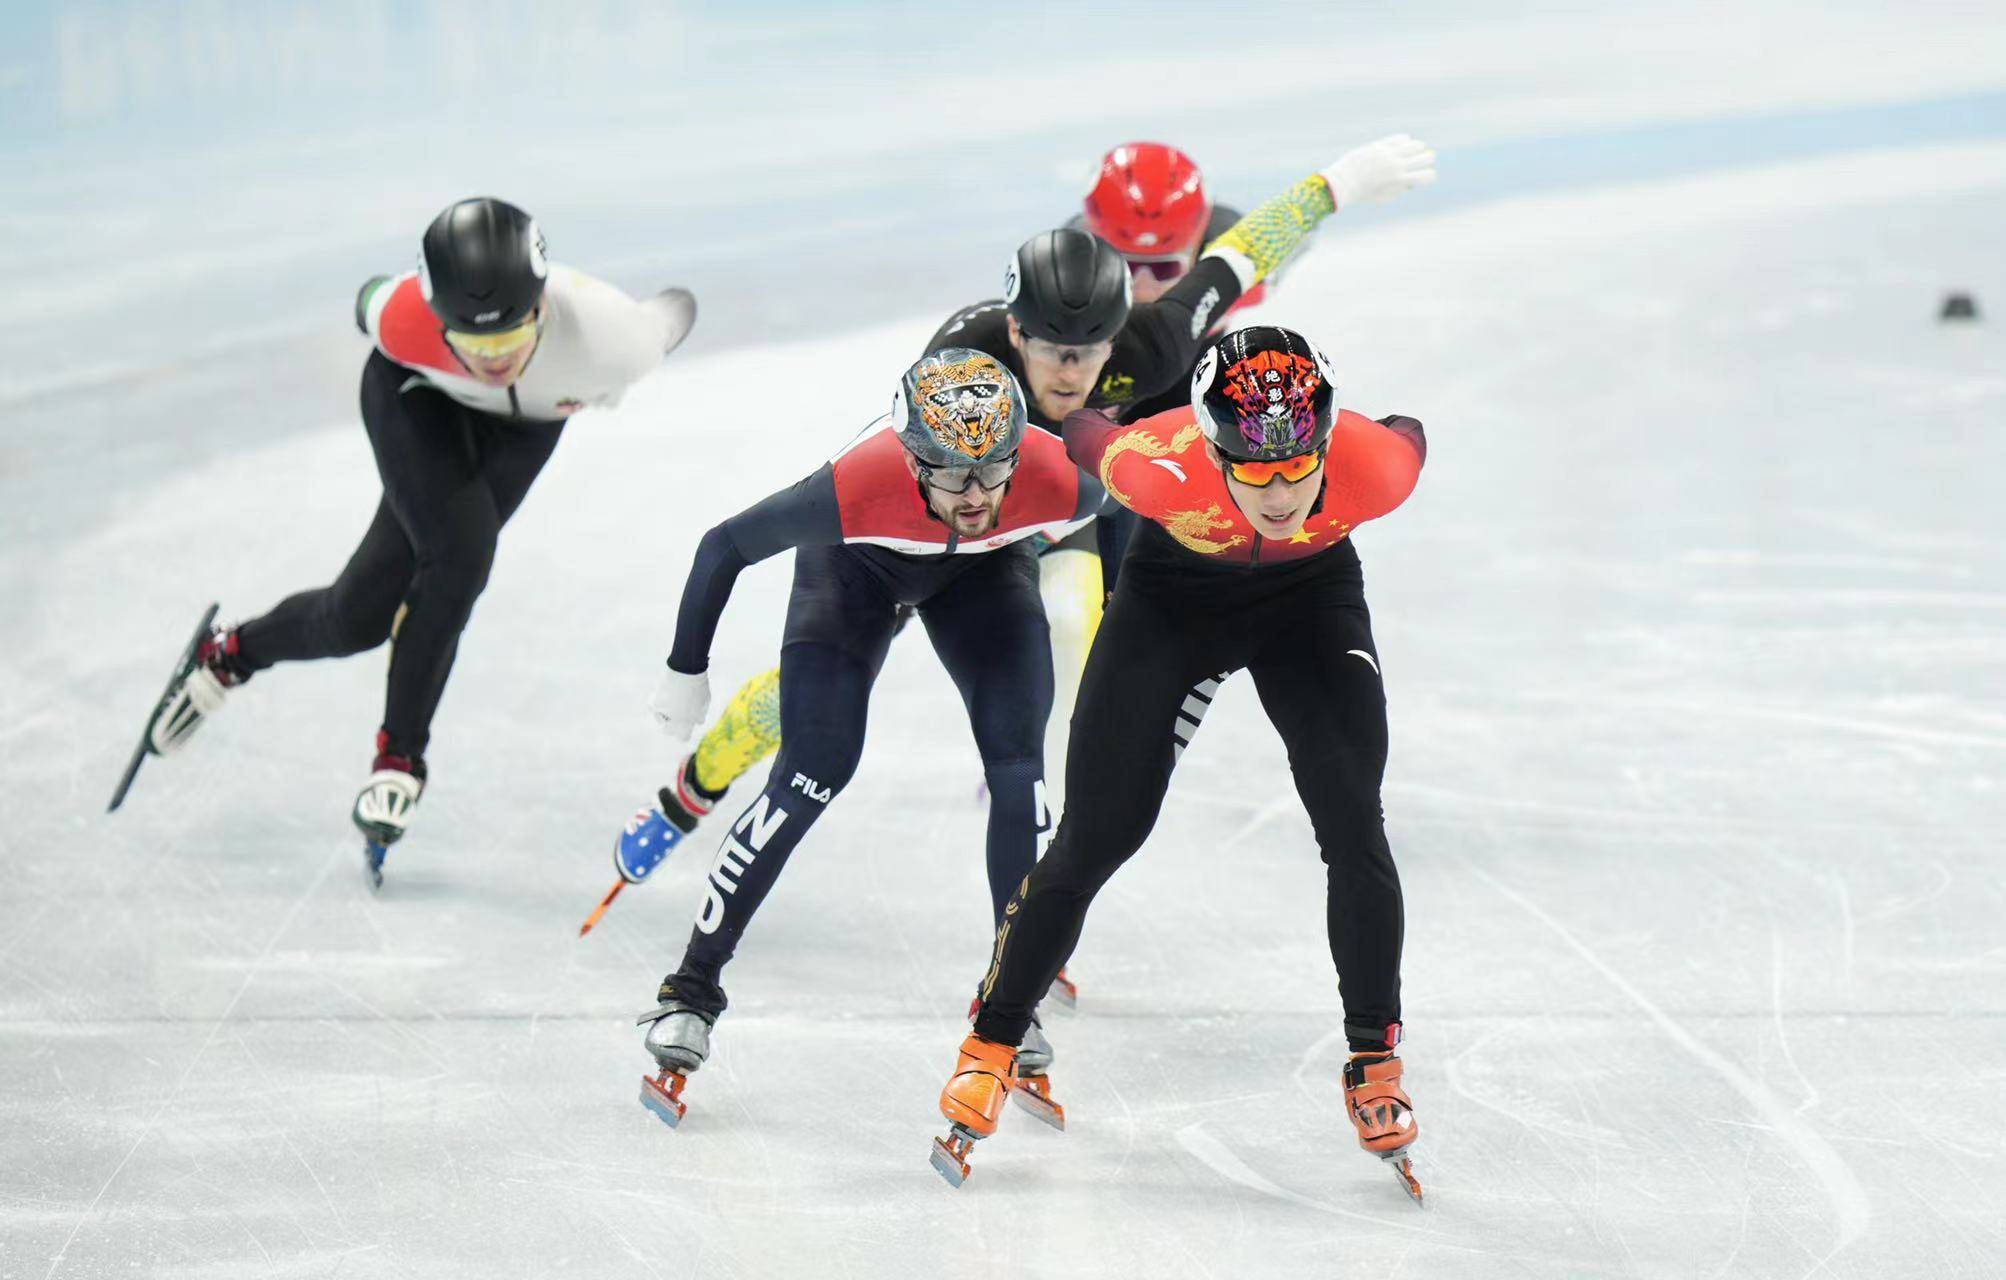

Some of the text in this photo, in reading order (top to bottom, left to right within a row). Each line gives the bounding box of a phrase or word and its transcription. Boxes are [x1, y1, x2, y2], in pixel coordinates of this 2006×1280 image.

[1264, 369, 1284, 402] 绝影
[790, 771, 831, 804] FILA
[695, 793, 789, 935] NED
